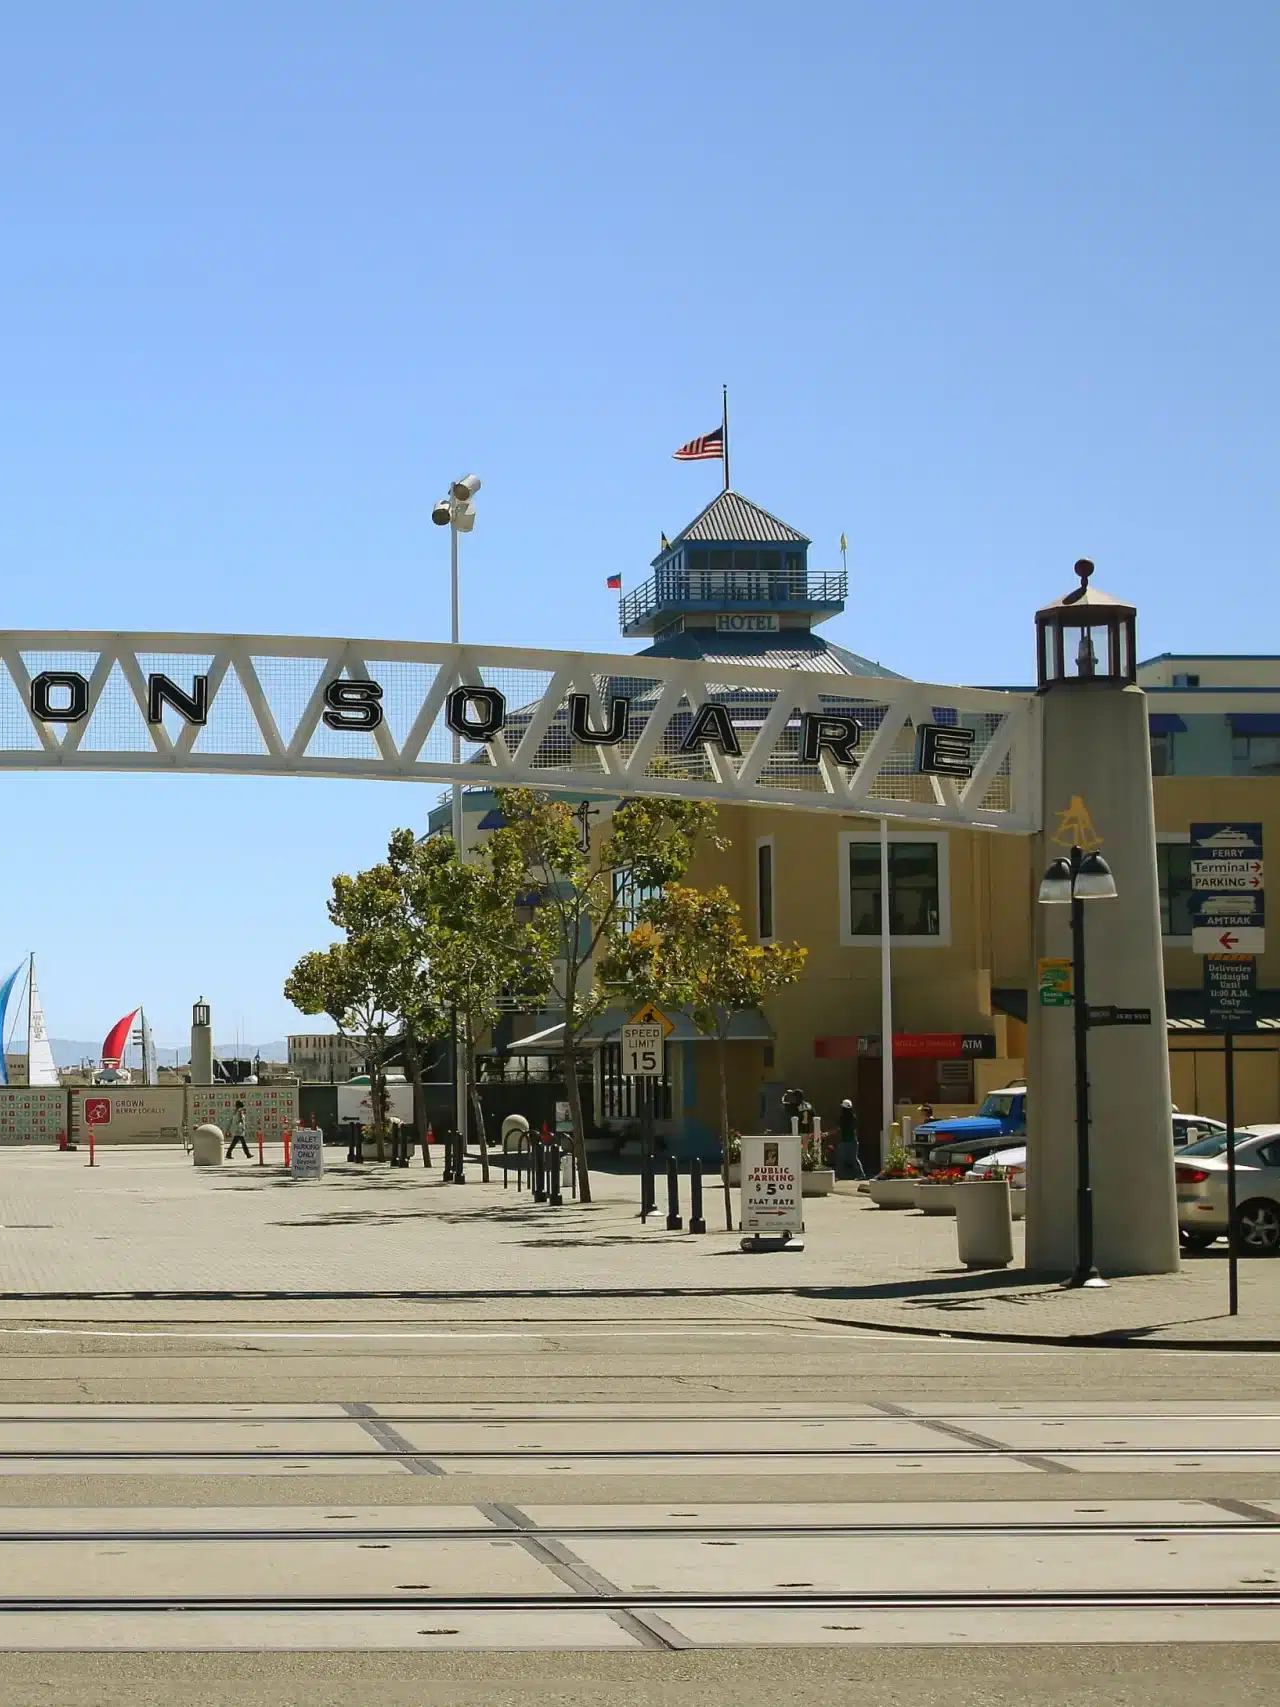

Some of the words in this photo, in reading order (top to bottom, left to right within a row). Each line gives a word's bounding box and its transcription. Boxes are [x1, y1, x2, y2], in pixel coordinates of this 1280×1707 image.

[716, 615, 777, 630] HOTEL
[322, 678, 976, 778] SQUARE
[1212, 849, 1244, 858] FERRY
[1193, 862, 1250, 873] Terminal
[1195, 878, 1246, 887] PARKING
[1206, 916, 1252, 925] AMTRAK
[1208, 963, 1252, 973] Deliveries
[1210, 972, 1250, 983] Midnight
[1220, 981, 1241, 989] Until
[1220, 998, 1241, 1007] Only
[624, 1028, 660, 1038] SPEED
[628, 1039, 656, 1048] LIMIT
[961, 1039, 983, 1049] ATM
[631, 1051, 657, 1071] 15
[115, 1099, 145, 1108] GROWN
[293, 1143, 320, 1151] PARKING
[297, 1150, 315, 1158] ONLY
[748, 1174, 796, 1182] PARKING
[748, 1198, 769, 1206] FLAT
[772, 1198, 795, 1206] RATE
